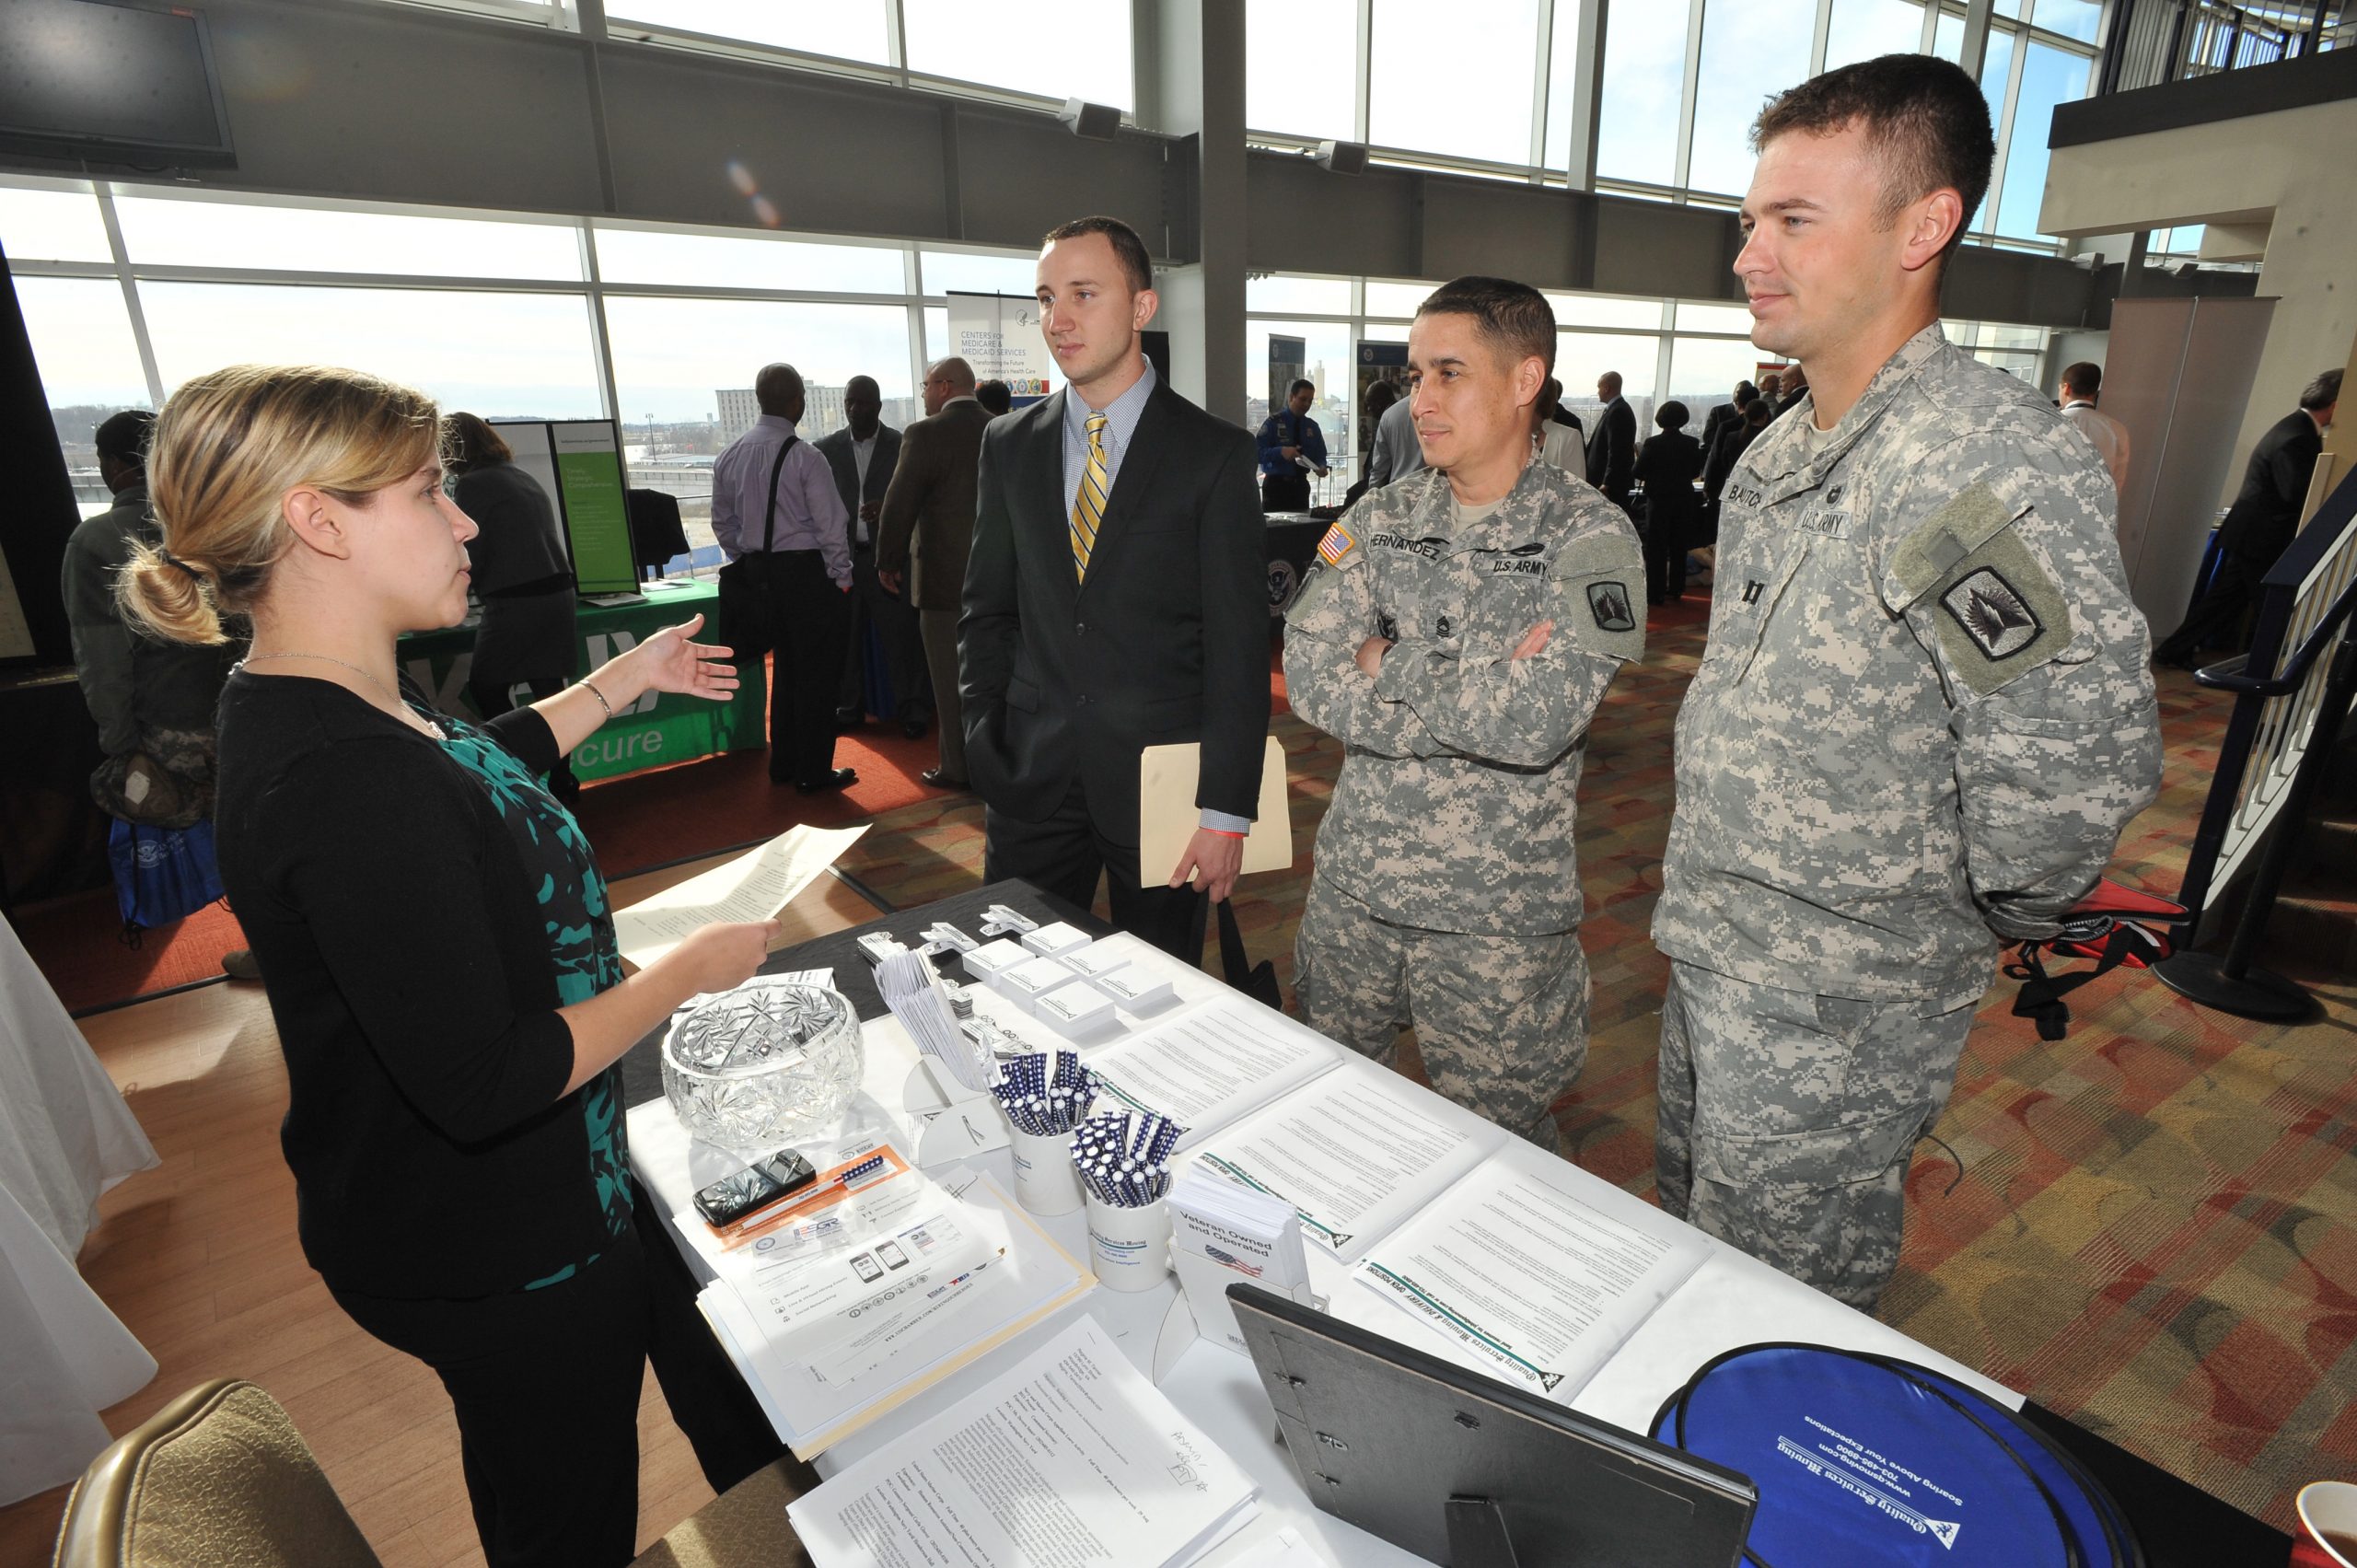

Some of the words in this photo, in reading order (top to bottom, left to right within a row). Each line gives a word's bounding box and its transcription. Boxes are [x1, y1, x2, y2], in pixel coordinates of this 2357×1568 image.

[1802, 510, 1818, 531] U.S.
[1818, 512, 1843, 534] ARMY
[1370, 533, 1440, 561] HERNANDEZ
[1493, 560, 1512, 573] U.S.
[1514, 561, 1548, 576] ARMY
[570, 730, 663, 767] cure
[1179, 1210, 1225, 1234] Veteran
[1228, 1230, 1272, 1250] Owned
[1188, 1223, 1210, 1236] and
[1213, 1232, 1269, 1258] Operated
[1364, 1263, 1392, 1284] POSITIONS
[1388, 1279, 1407, 1294] OPEN
[1404, 1292, 1438, 1317] DELIVERY
[1425, 1290, 1435, 1299] call
[1434, 1312, 1443, 1321] &
[1438, 1316, 1472, 1342] Moving
[1482, 1328, 1502, 1343] resumes
[1500, 1340, 1513, 1351] Send
[1469, 1336, 1505, 1364] Services
[1503, 1356, 1538, 1382] Quality
[1802, 1414, 1864, 1451] Expectations
[1773, 1441, 1825, 1476] Moving
[1834, 1442, 1899, 1481] 703-495-8900
[1863, 1446, 1888, 1465] Your
[1817, 1441, 1913, 1498] www.qsmoving.com
[1887, 1460, 1922, 1483] Above
[1821, 1469, 1878, 1506] Services
[1920, 1477, 1965, 1506] Soaring
[1875, 1498, 1930, 1535] Quality
